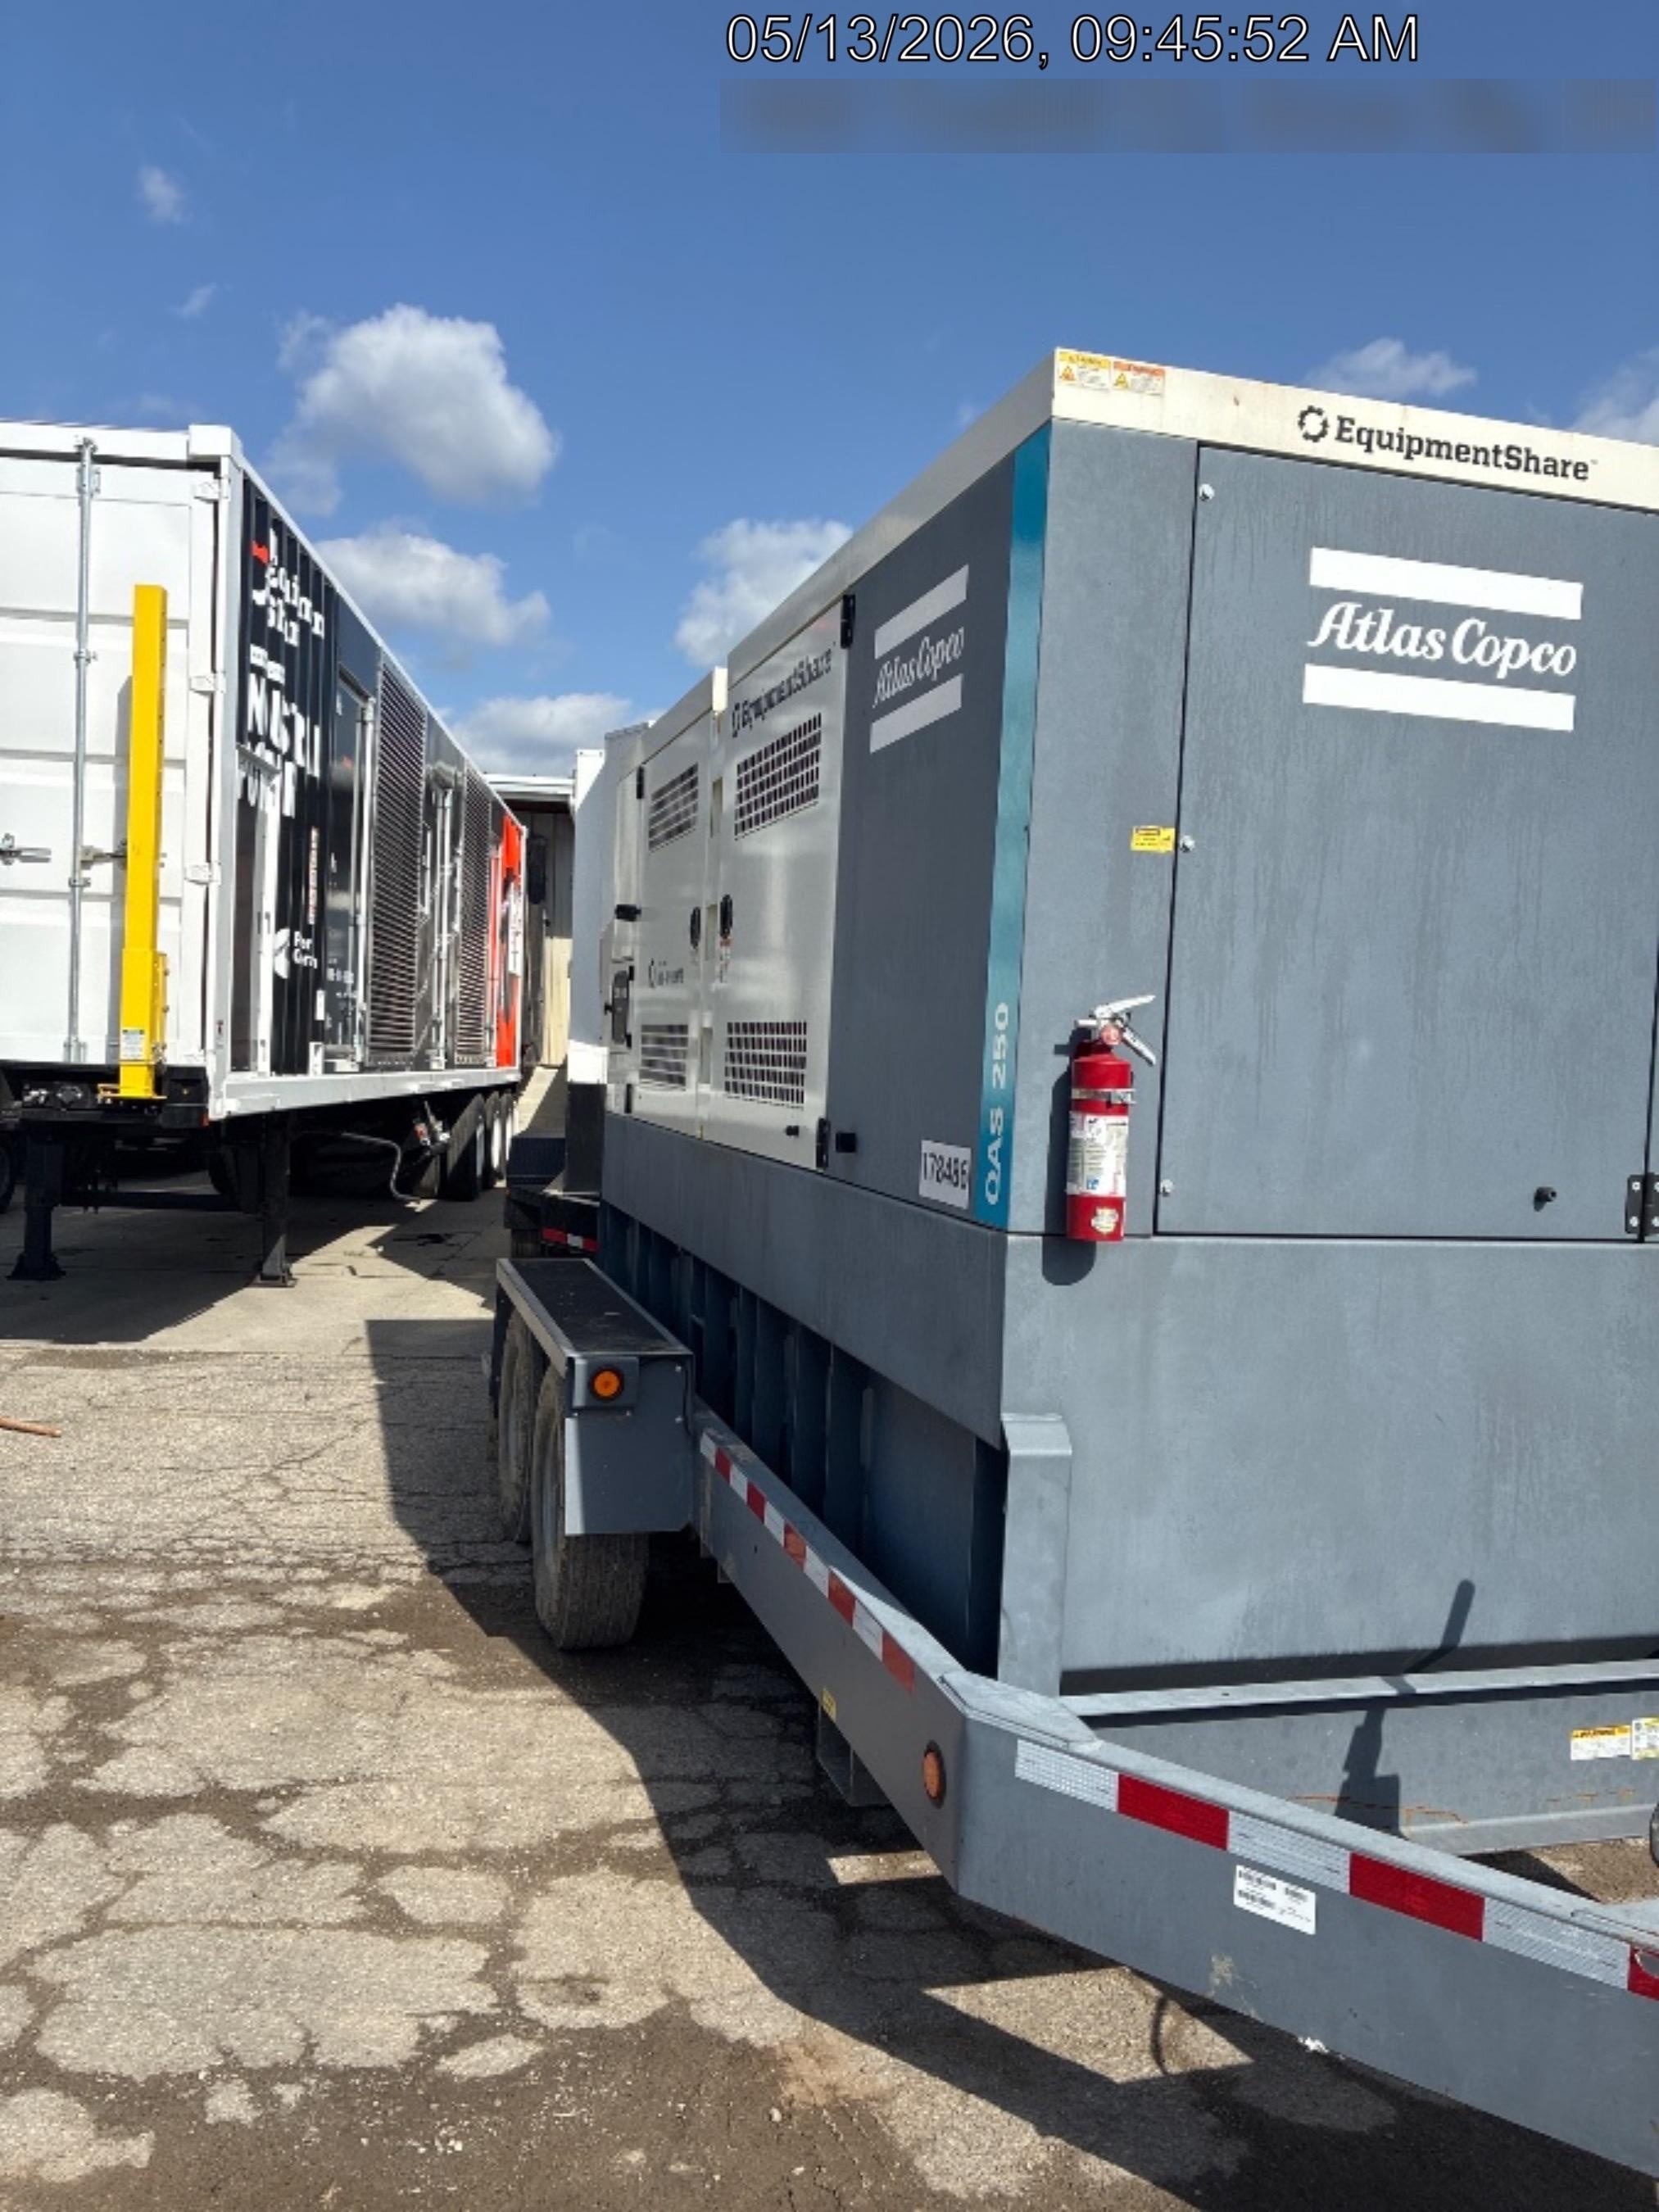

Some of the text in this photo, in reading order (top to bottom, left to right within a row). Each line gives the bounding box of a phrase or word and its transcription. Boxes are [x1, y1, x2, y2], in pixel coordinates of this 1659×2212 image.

[1335, 415, 1589, 481] EquipmentShare
[872, 626, 965, 709] Atlas Copco
[1307, 601, 1577, 680] Atlas Copco
[986, 1002, 1009, 1206] QAS 250
